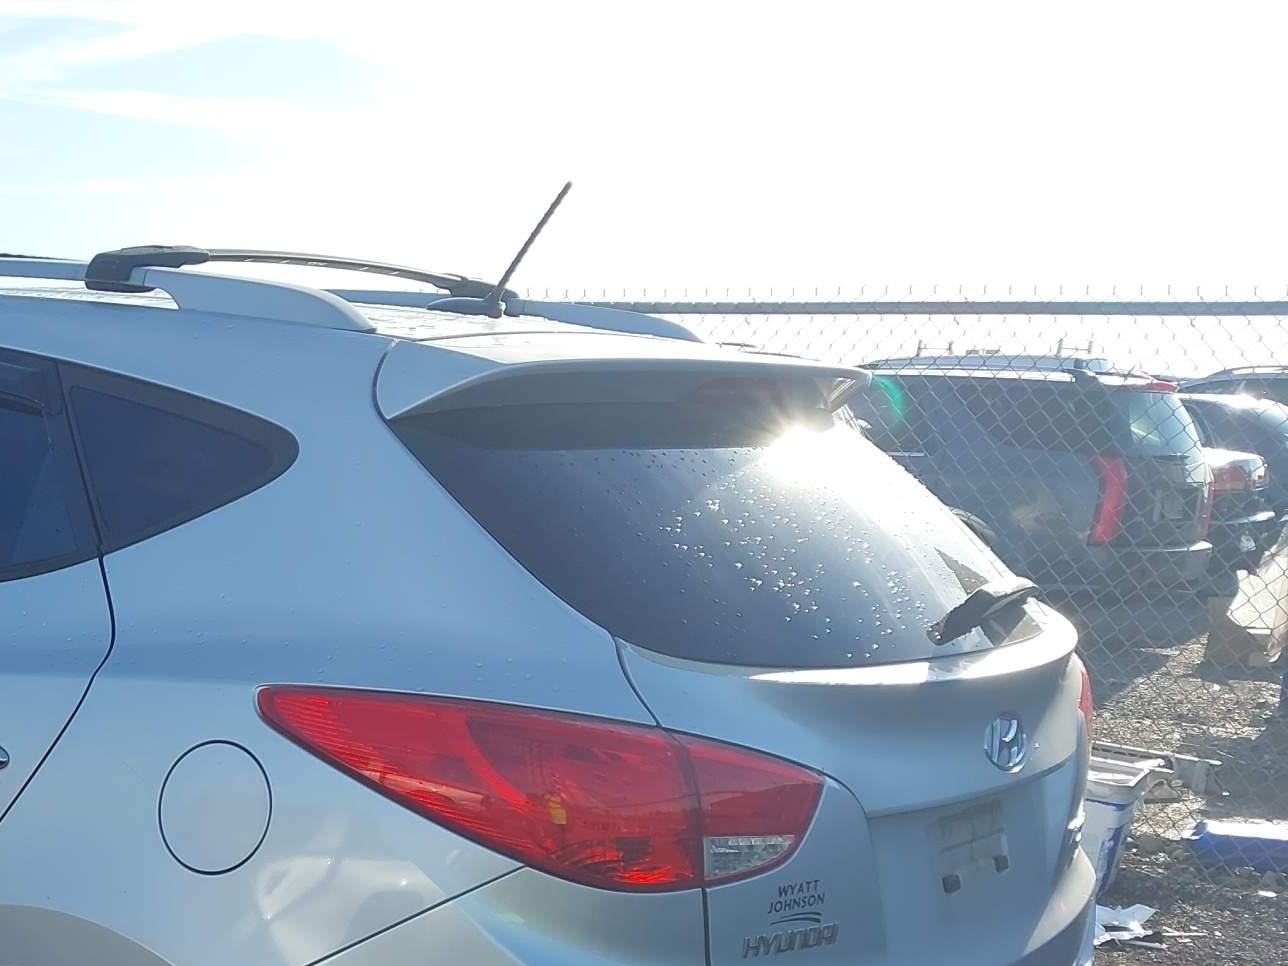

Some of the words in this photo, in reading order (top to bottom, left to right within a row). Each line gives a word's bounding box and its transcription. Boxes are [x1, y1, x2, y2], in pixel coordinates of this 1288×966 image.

[778, 879, 820, 898] WYATT
[768, 893, 825, 914] JOHNSON
[743, 922, 840, 959] HYUNDAI
